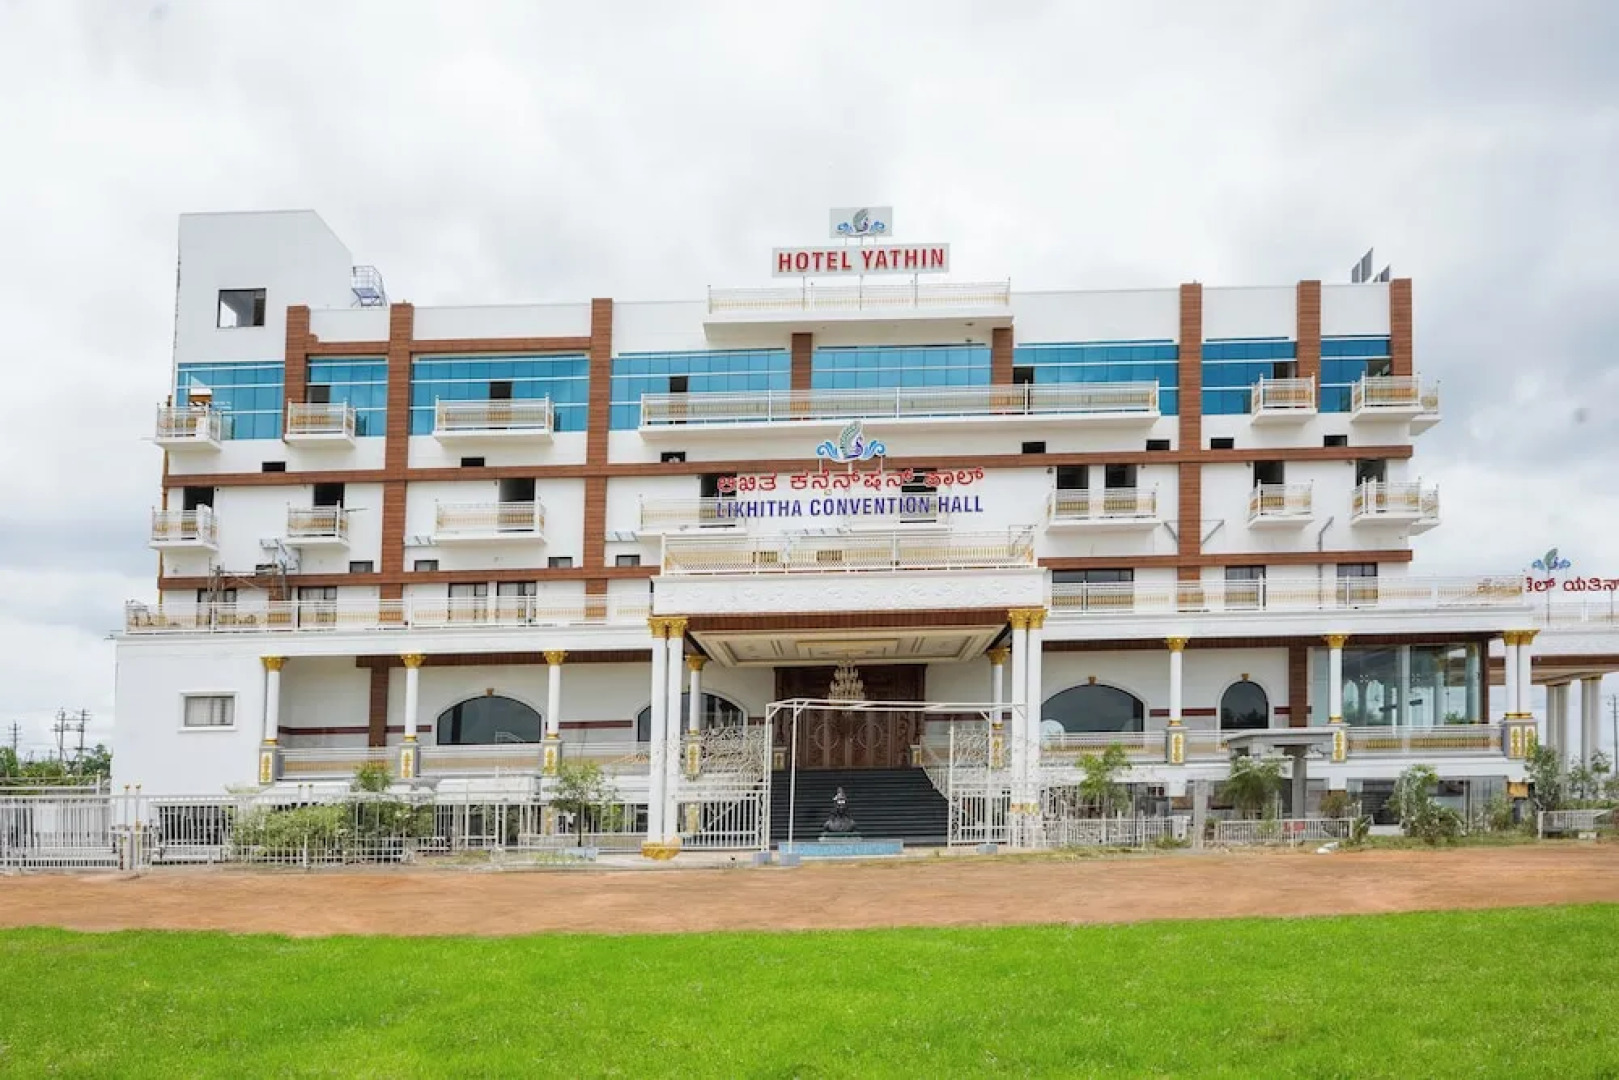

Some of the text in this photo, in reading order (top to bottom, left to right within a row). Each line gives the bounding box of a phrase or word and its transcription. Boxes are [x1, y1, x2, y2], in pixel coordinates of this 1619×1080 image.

[778, 248, 944, 272] HOTEL YATHIN
[716, 495, 984, 518] LIKHITHA CONVENTION HALL
